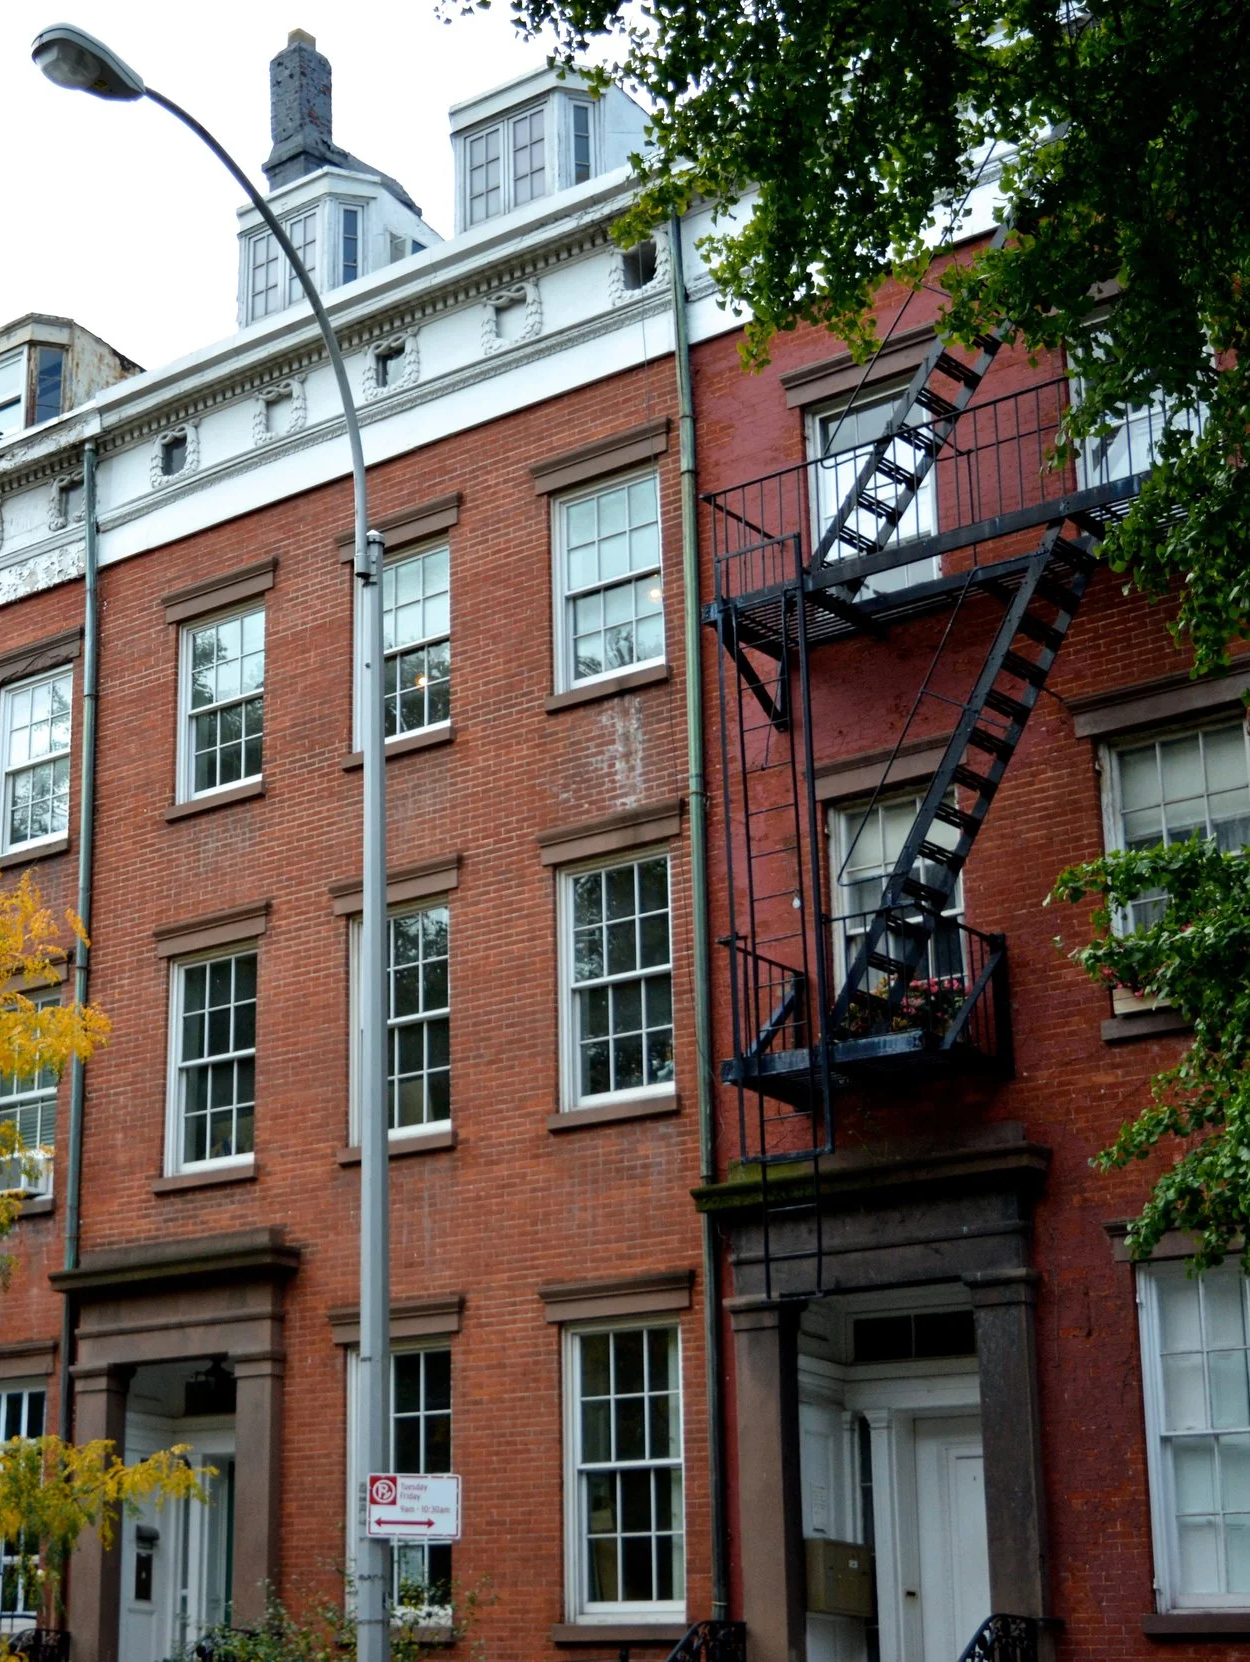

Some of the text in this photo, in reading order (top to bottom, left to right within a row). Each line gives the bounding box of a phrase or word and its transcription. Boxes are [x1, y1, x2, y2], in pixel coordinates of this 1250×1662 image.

[401, 1482, 428, 1492] Tuesday
[400, 1492, 421, 1502] Friday
[400, 1505, 415, 1513] 9am
[421, 1505, 451, 1514] 10:30am
